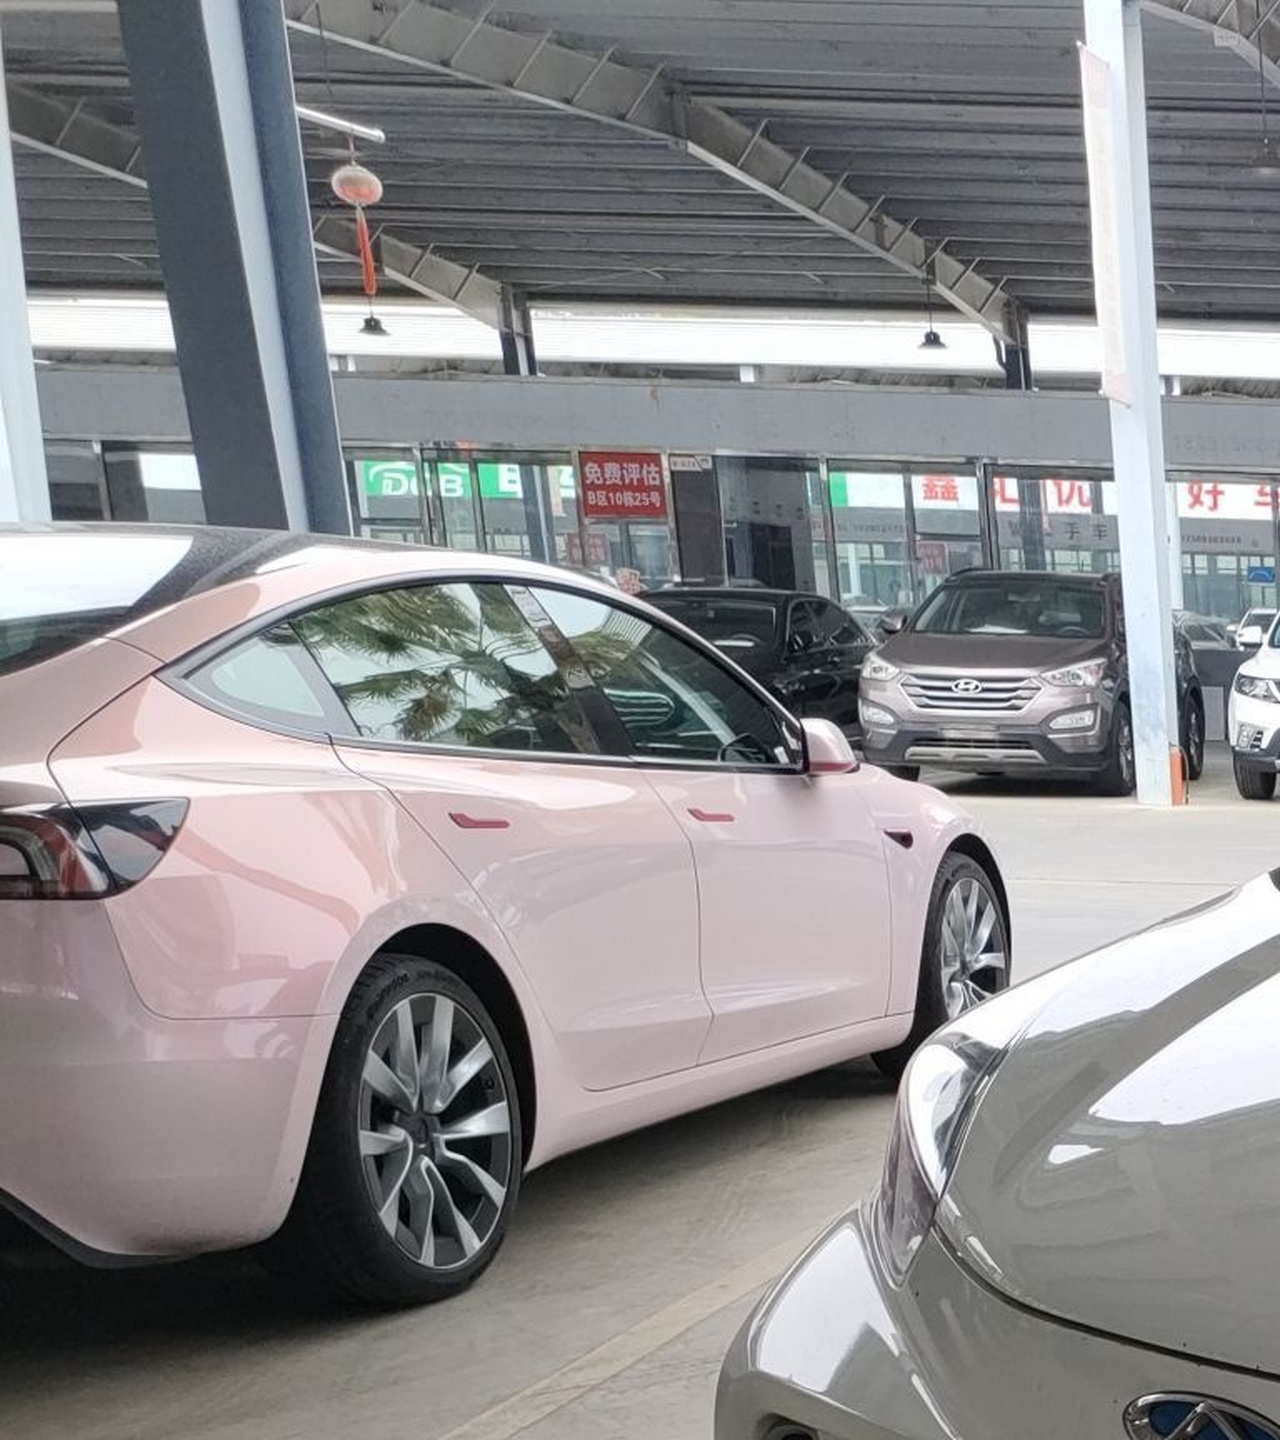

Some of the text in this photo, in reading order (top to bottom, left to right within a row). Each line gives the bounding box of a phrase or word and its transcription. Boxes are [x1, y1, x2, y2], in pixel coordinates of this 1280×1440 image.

[584, 461, 661, 487] 免费评估
[587, 490, 661, 508] B区10栋25号
